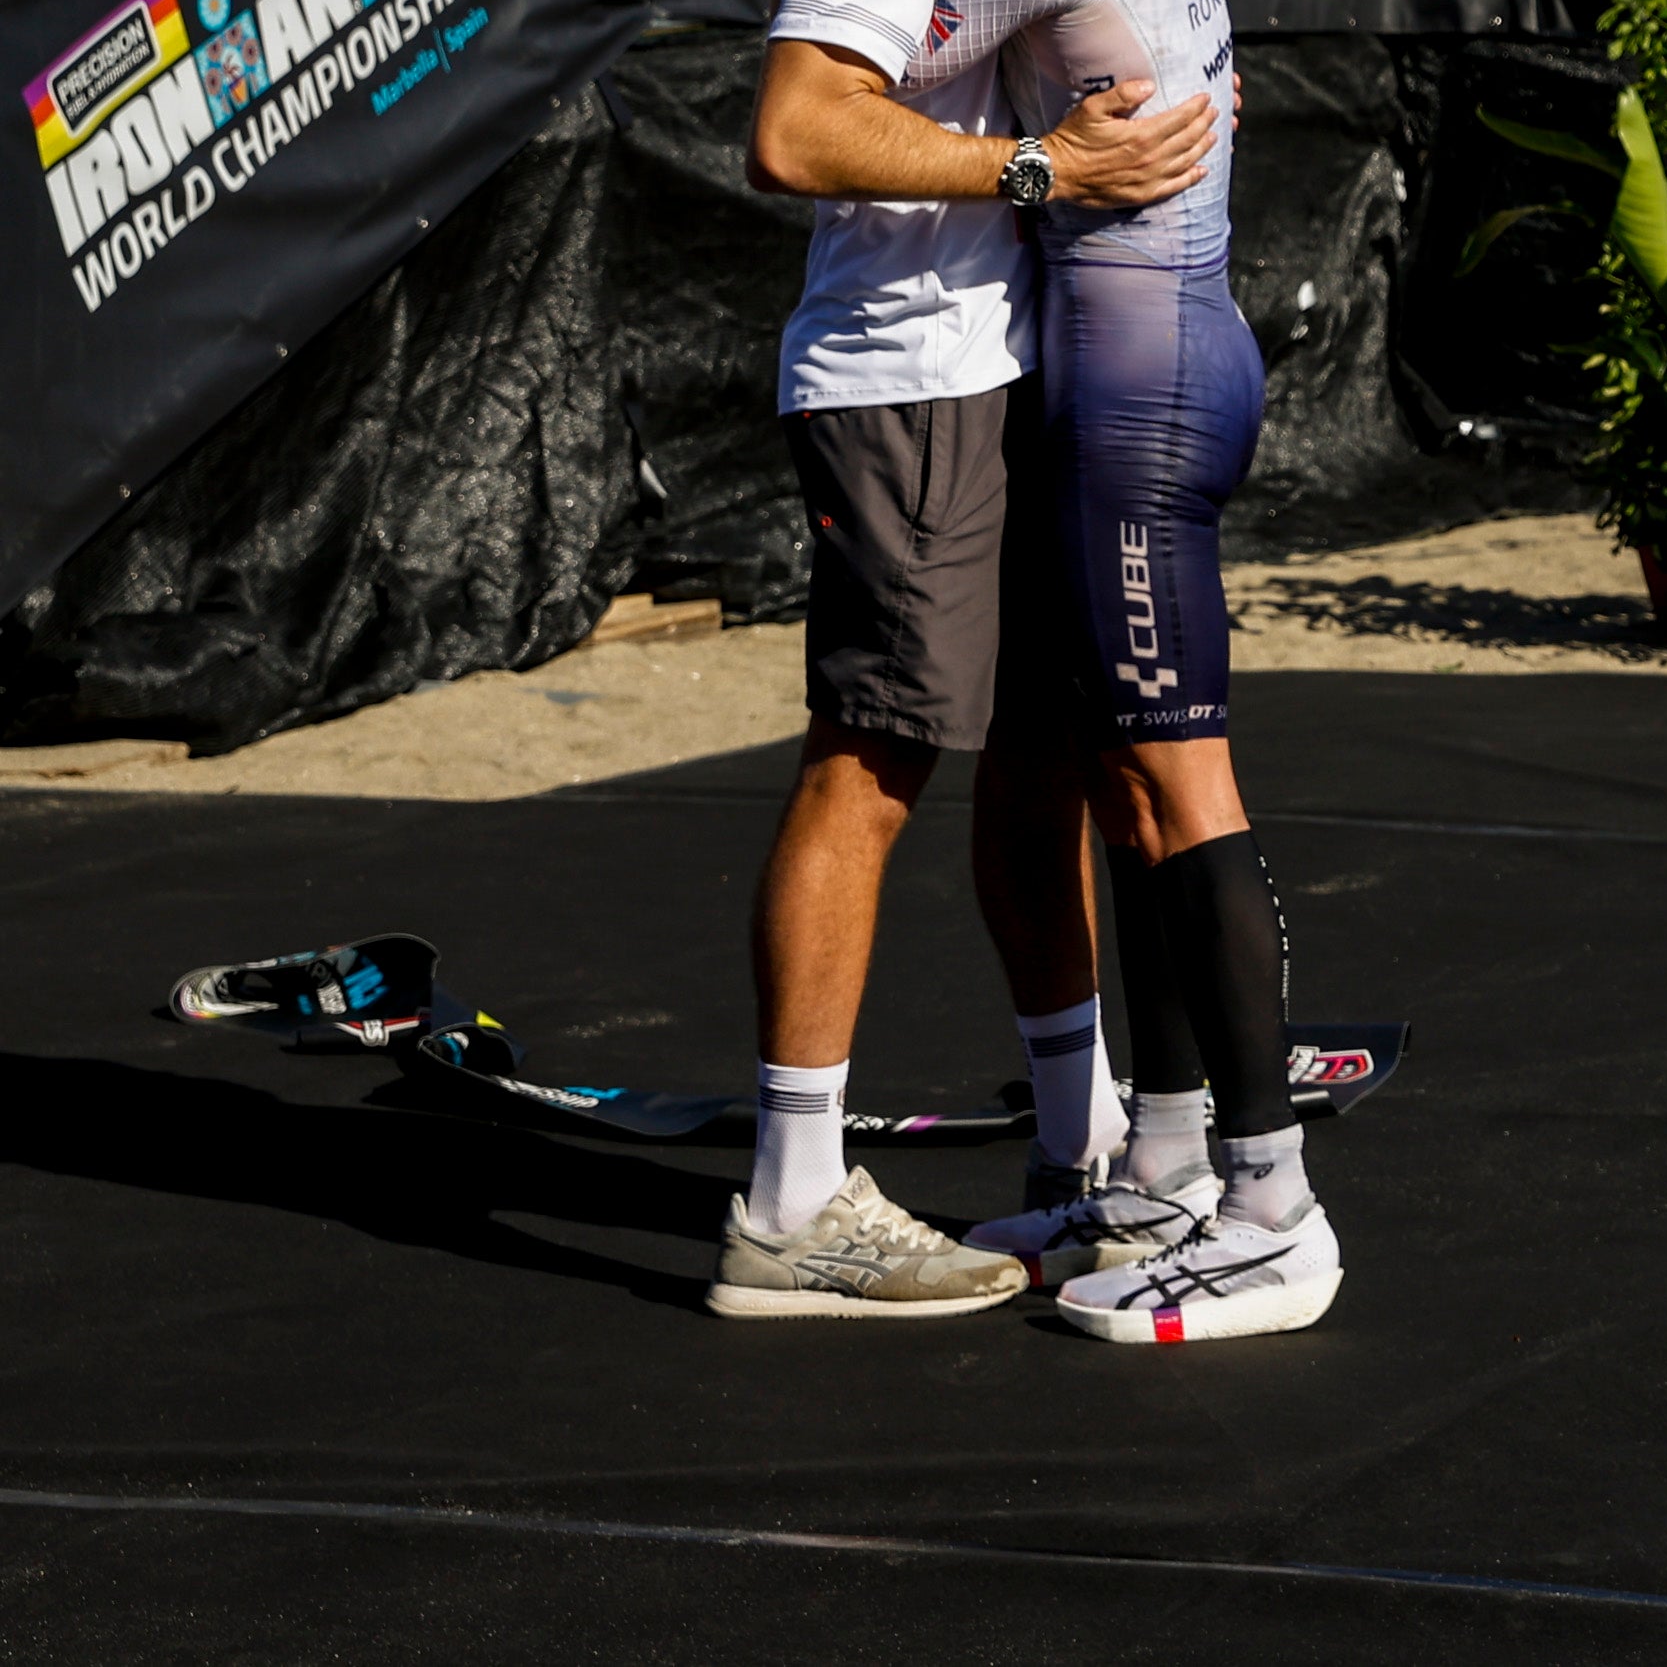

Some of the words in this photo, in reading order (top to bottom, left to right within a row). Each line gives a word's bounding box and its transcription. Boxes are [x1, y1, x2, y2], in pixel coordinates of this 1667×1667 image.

[56, 17, 146, 107] PRECISION
[370, 48, 438, 116] Marbella
[443, 7, 490, 53] Spain
[71, 164, 217, 313] WORLD
[1119, 520, 1160, 659] CUBE
[1188, 704, 1217, 721] DT
